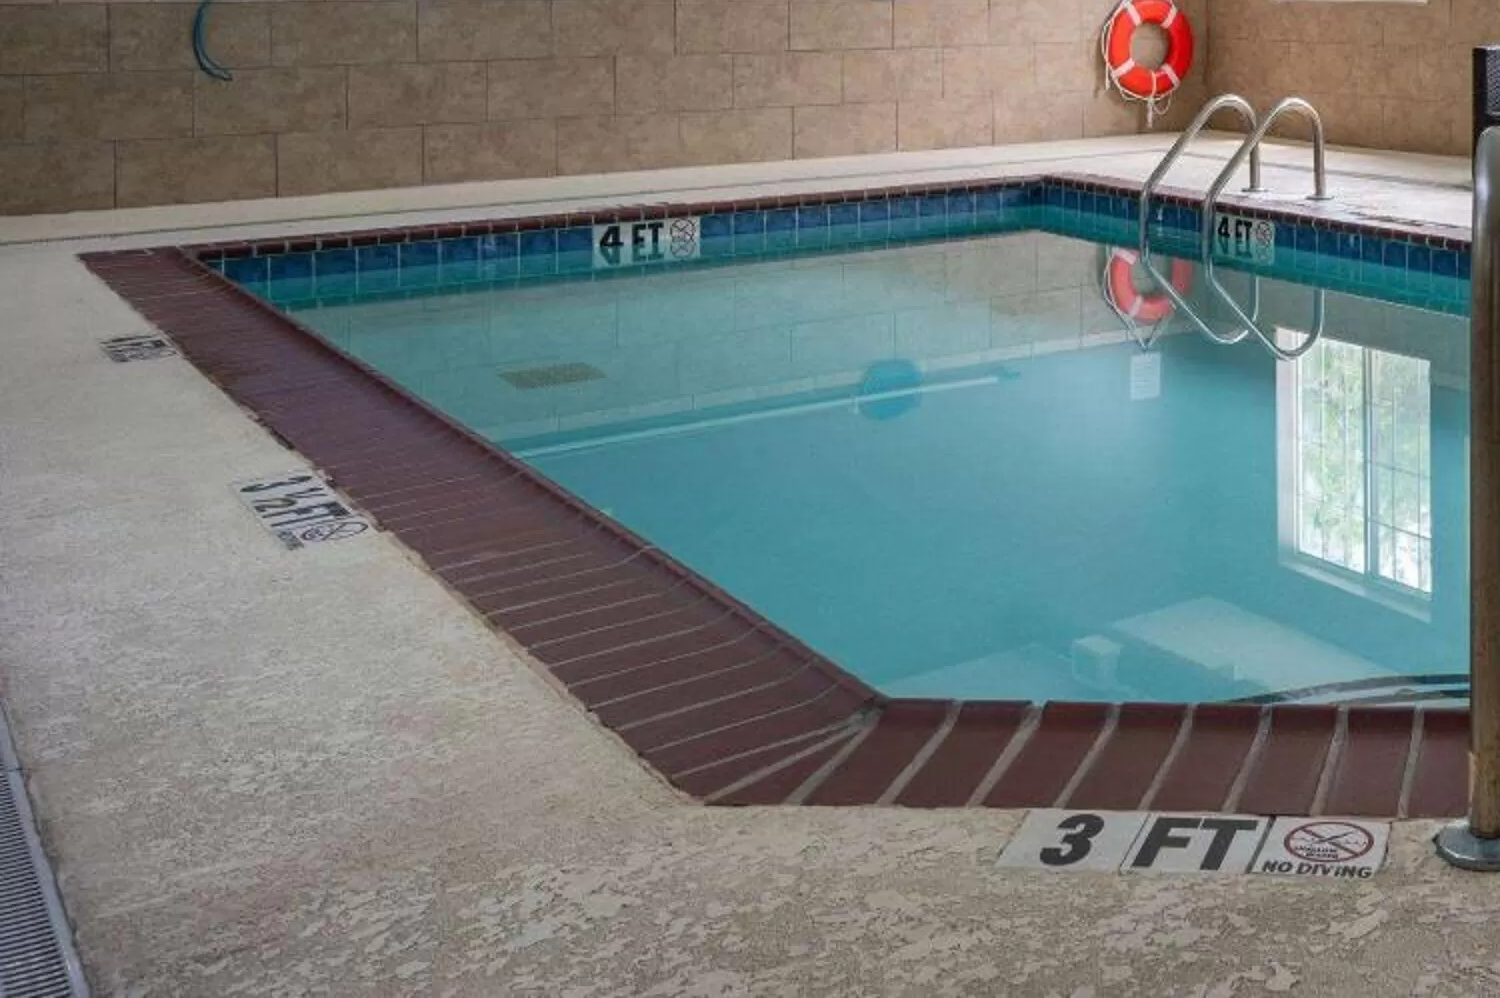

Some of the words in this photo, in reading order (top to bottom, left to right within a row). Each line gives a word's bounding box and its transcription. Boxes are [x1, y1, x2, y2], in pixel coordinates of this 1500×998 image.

[599, 225, 625, 248] 4
[1217, 215, 1231, 240] 4
[1039, 813, 1105, 867] 3
[1131, 817, 1259, 871] FT
[1262, 860, 1293, 873] NO
[1296, 862, 1373, 879] DIVING
